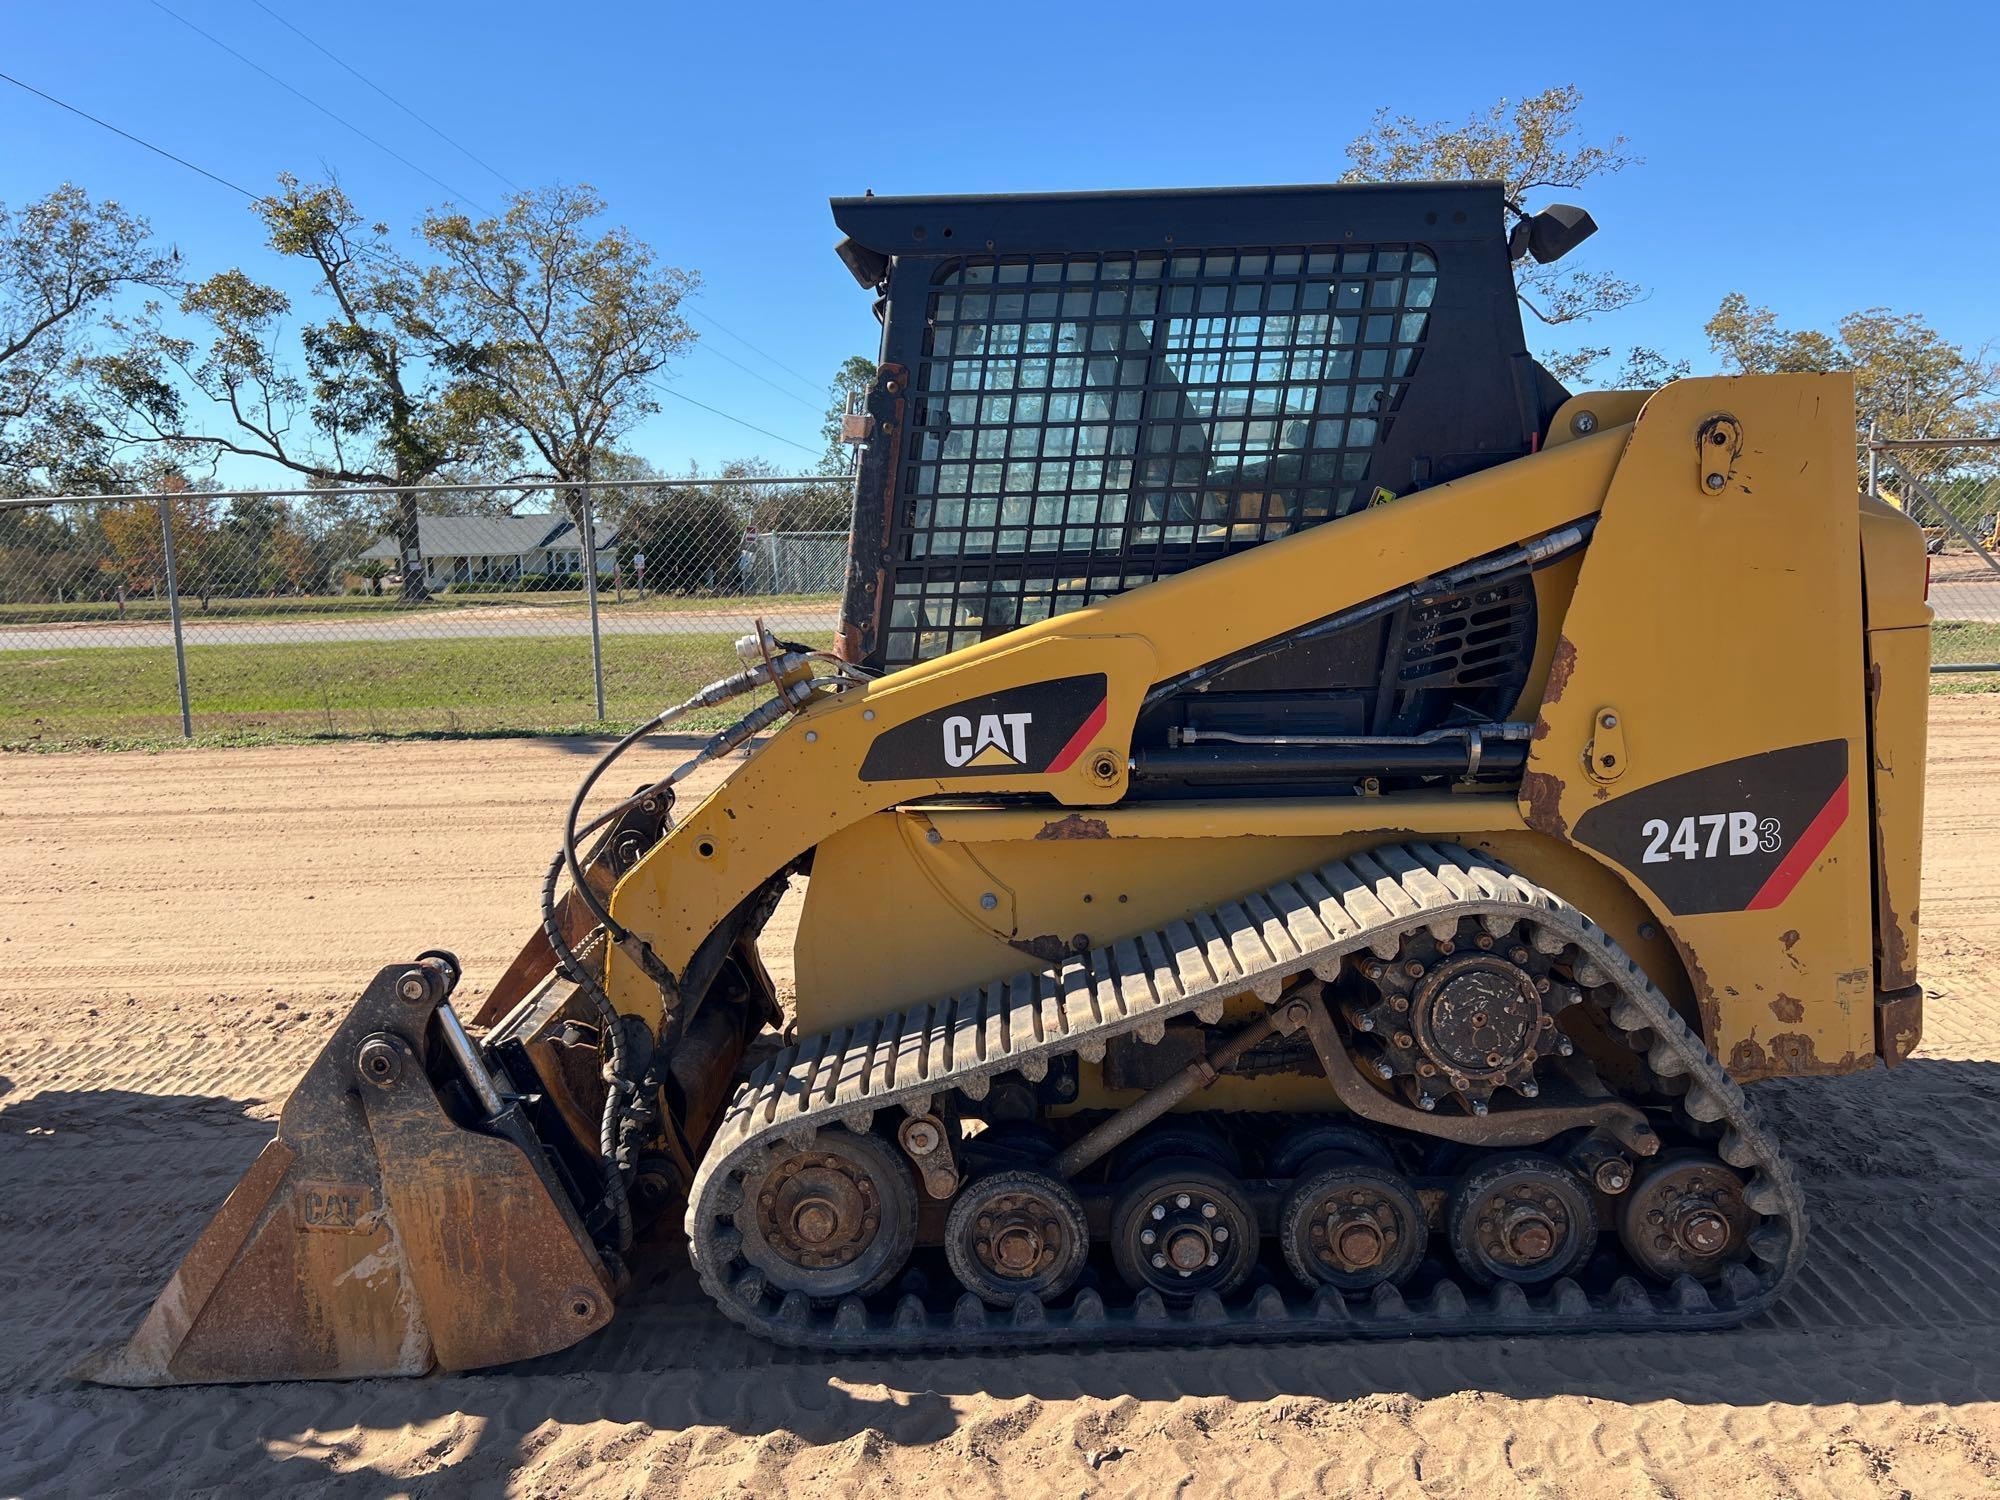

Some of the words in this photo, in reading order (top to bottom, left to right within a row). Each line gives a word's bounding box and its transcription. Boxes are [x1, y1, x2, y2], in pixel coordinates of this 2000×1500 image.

[943, 713, 1032, 767] CAT
[1642, 811, 1782, 863] 247B3
[305, 1192, 360, 1226] CAT
